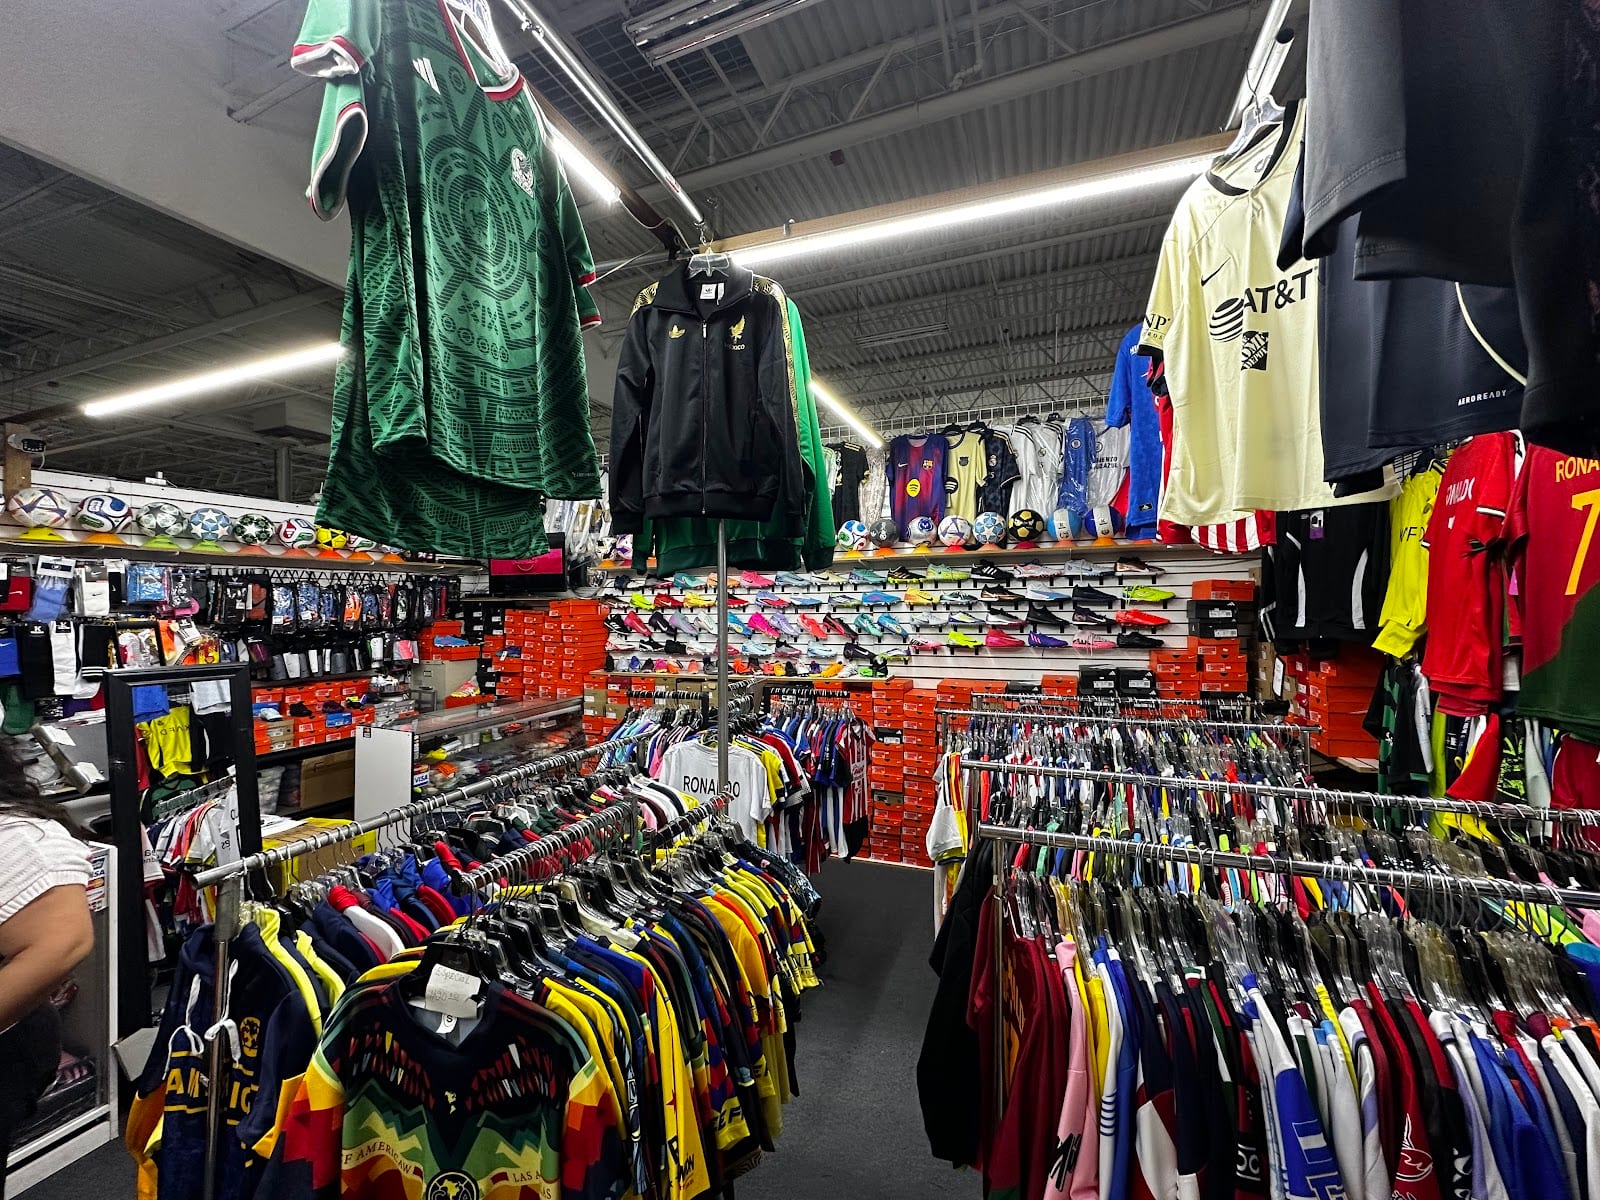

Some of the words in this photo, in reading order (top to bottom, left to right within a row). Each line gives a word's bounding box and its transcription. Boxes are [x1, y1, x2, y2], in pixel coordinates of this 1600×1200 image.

[1244, 268, 1313, 313] AT&T
[1457, 389, 1507, 407] AEROREADY
[1564, 488, 1600, 596] 7
[446, 1014, 453, 1023] S
